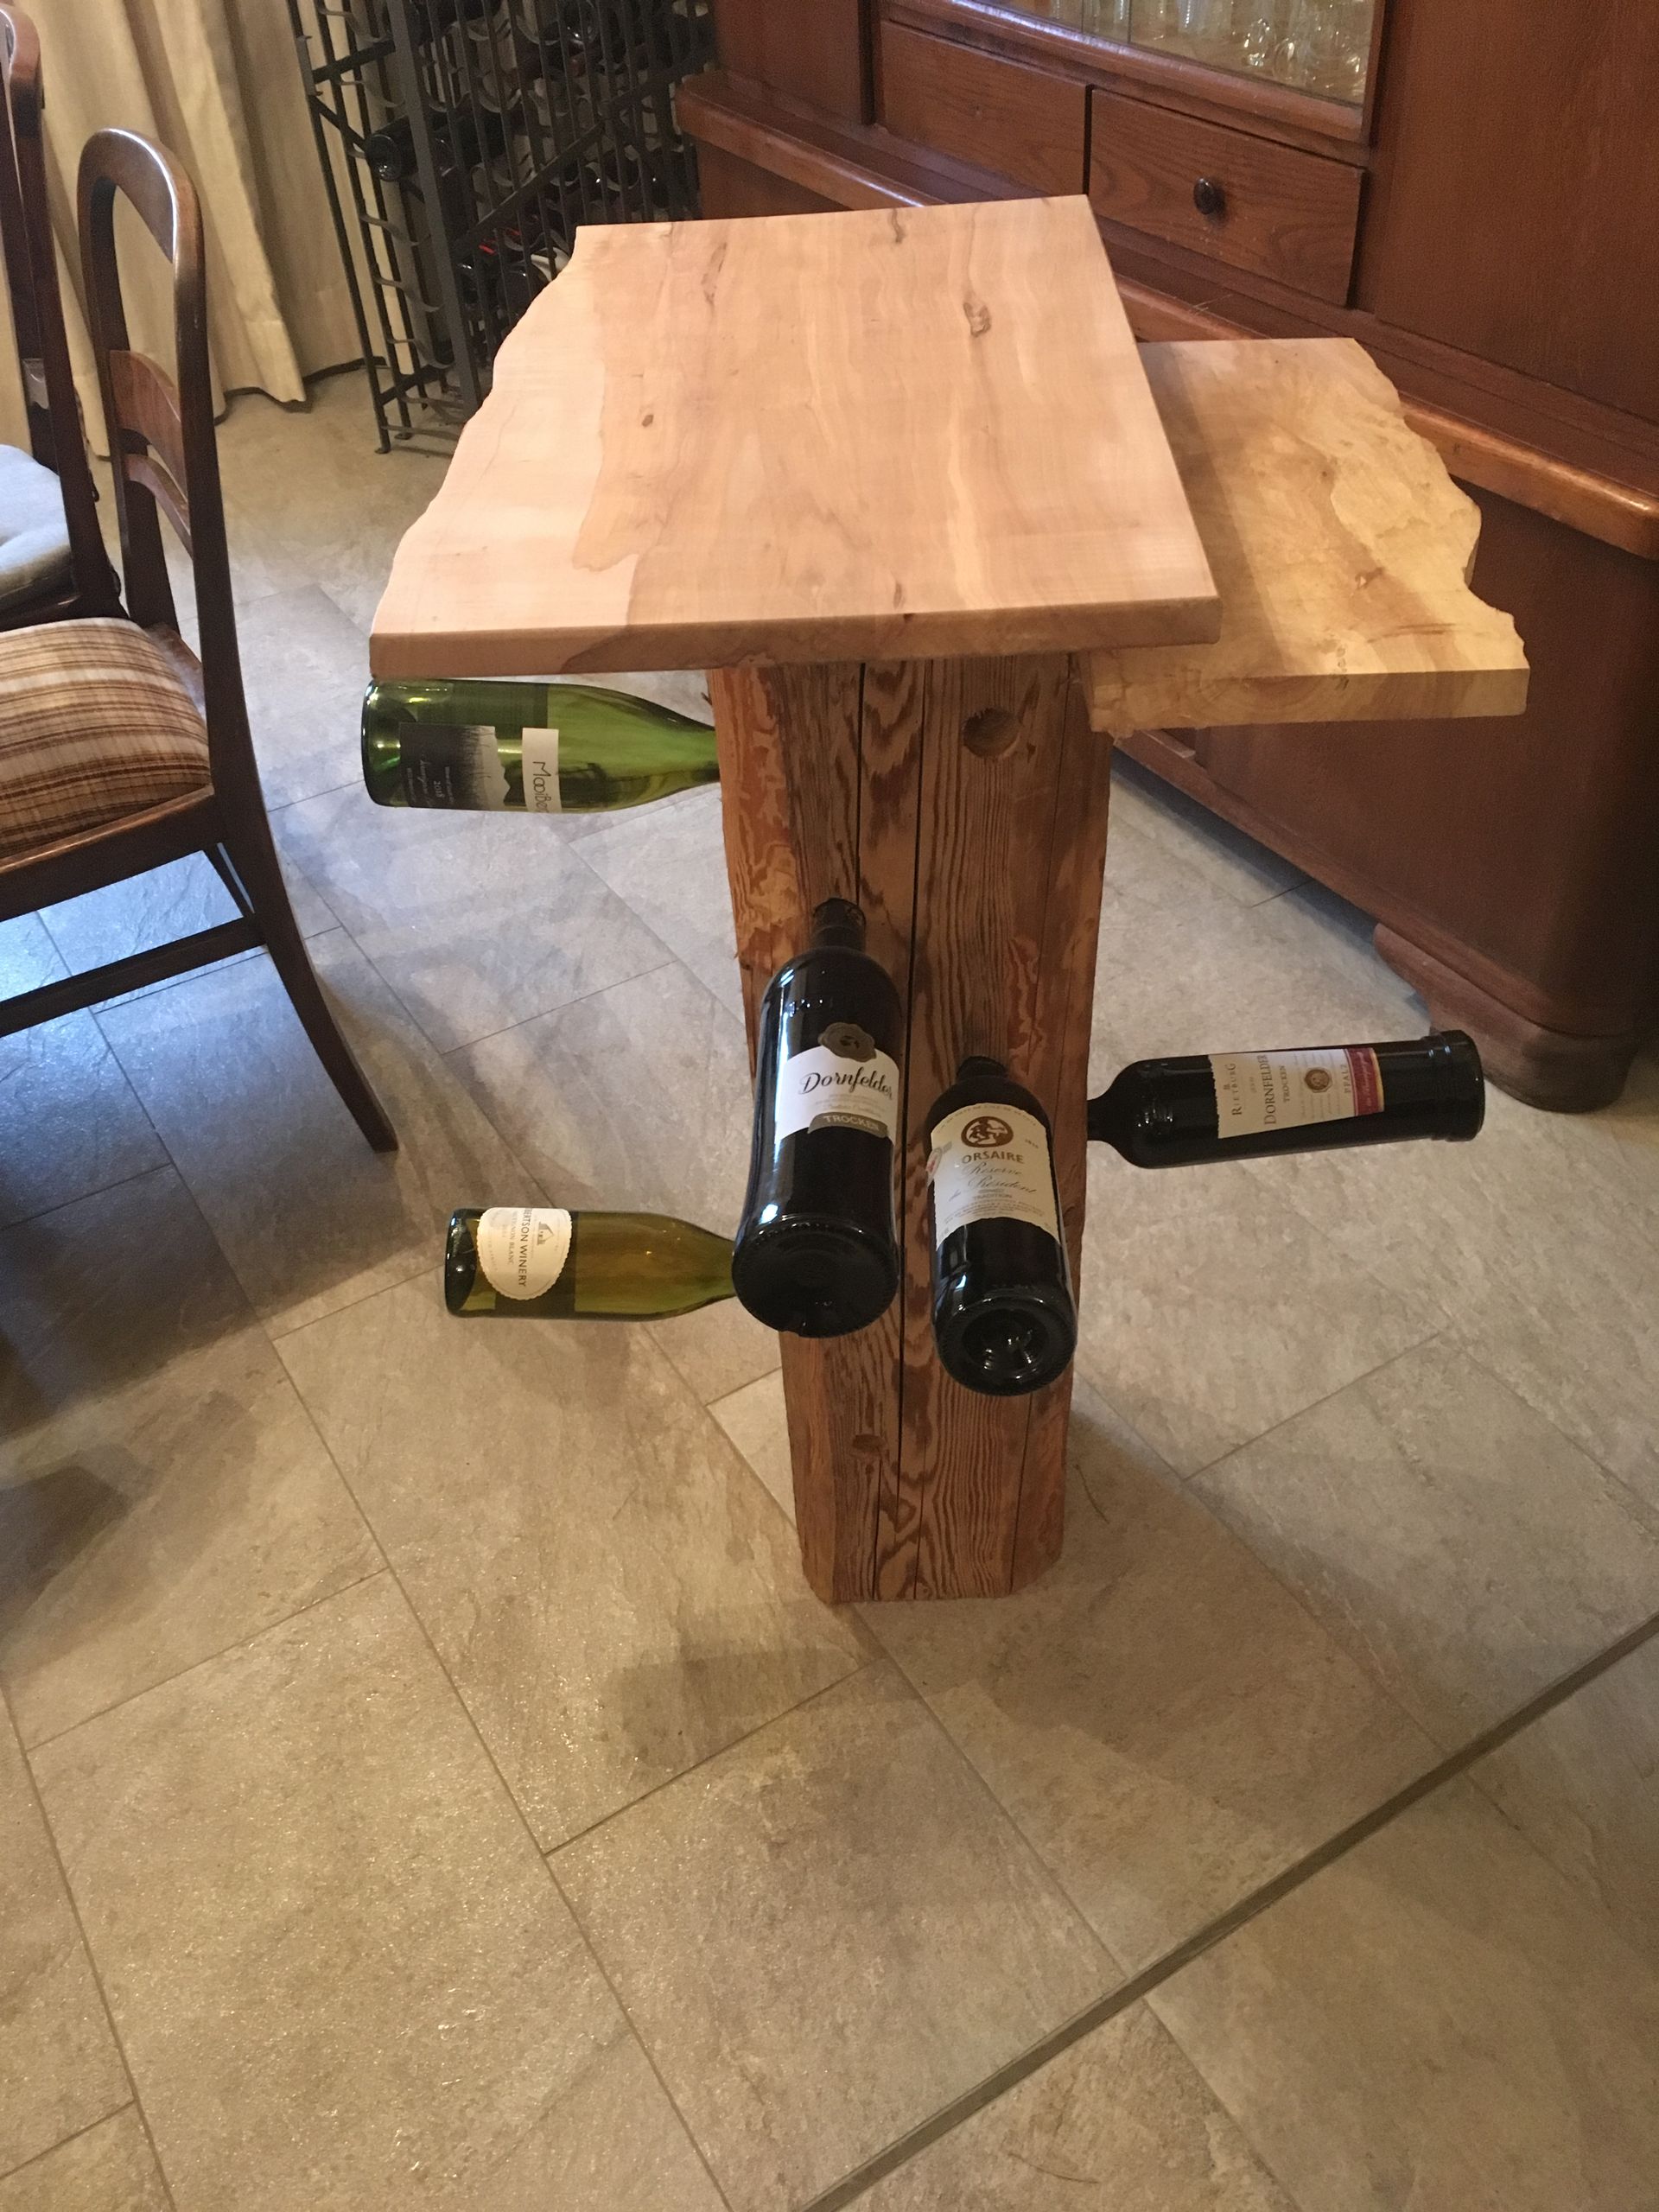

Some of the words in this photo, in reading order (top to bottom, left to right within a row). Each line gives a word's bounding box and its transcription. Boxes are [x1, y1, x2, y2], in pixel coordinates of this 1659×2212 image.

[799, 1066, 893, 1101] Dornfelder
[1256, 1054, 1276, 1125] DORNFELDER
[518, 1244, 530, 1287] WINERY
